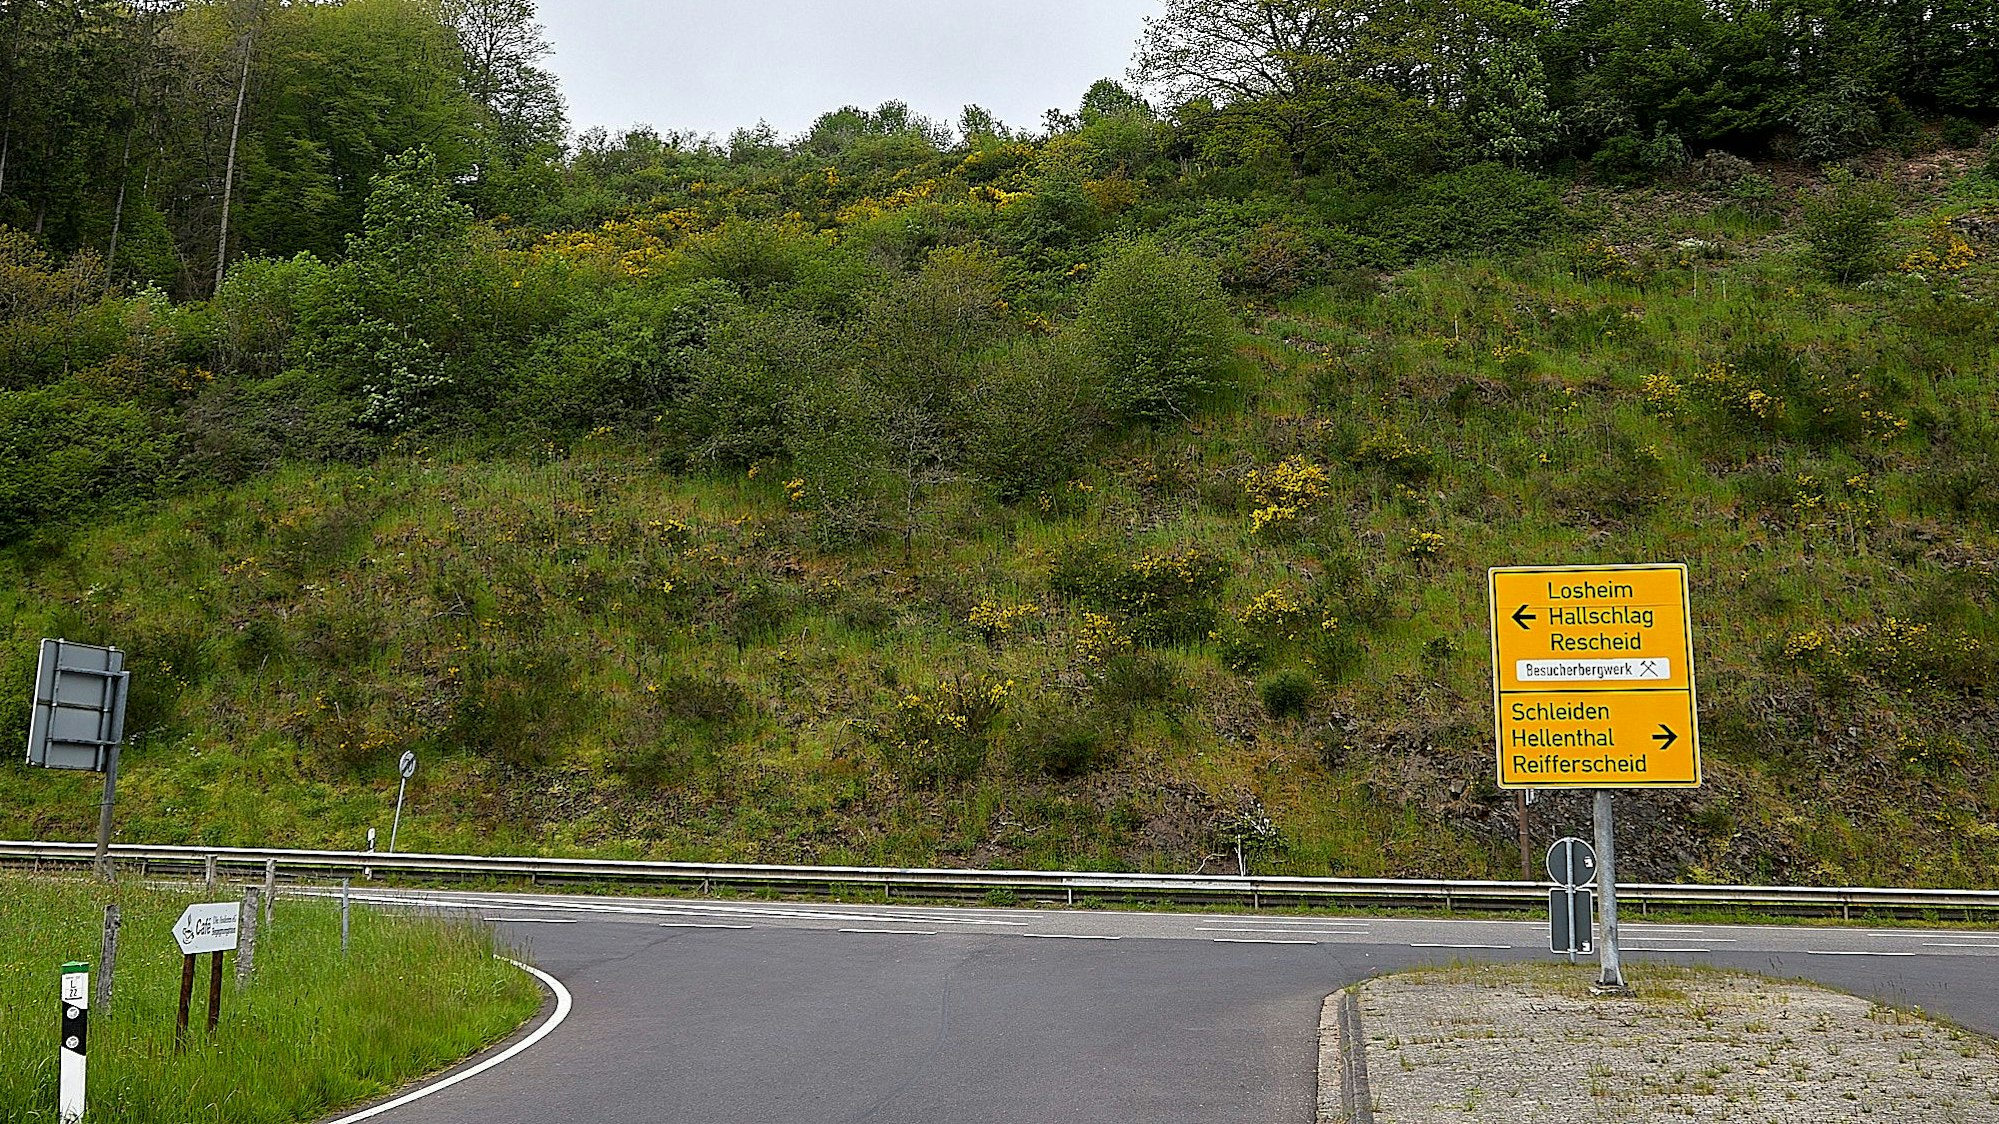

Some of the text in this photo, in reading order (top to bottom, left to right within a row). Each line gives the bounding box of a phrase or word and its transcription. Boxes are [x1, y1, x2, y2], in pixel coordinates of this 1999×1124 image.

[1548, 581, 1633, 599] Losheim
[1549, 606, 1653, 627] Hallschlag
[1551, 632, 1641, 651] Rescheid
[1526, 663, 1633, 679] Besucherbergwerk
[1512, 702, 1609, 721] Schleiden
[1512, 728, 1615, 747] Hellenthal
[1513, 754, 1647, 774] Reifferscheid
[196, 917, 212, 936] Café
[69, 988, 78, 997] 22
[70, 980, 77, 988] L
